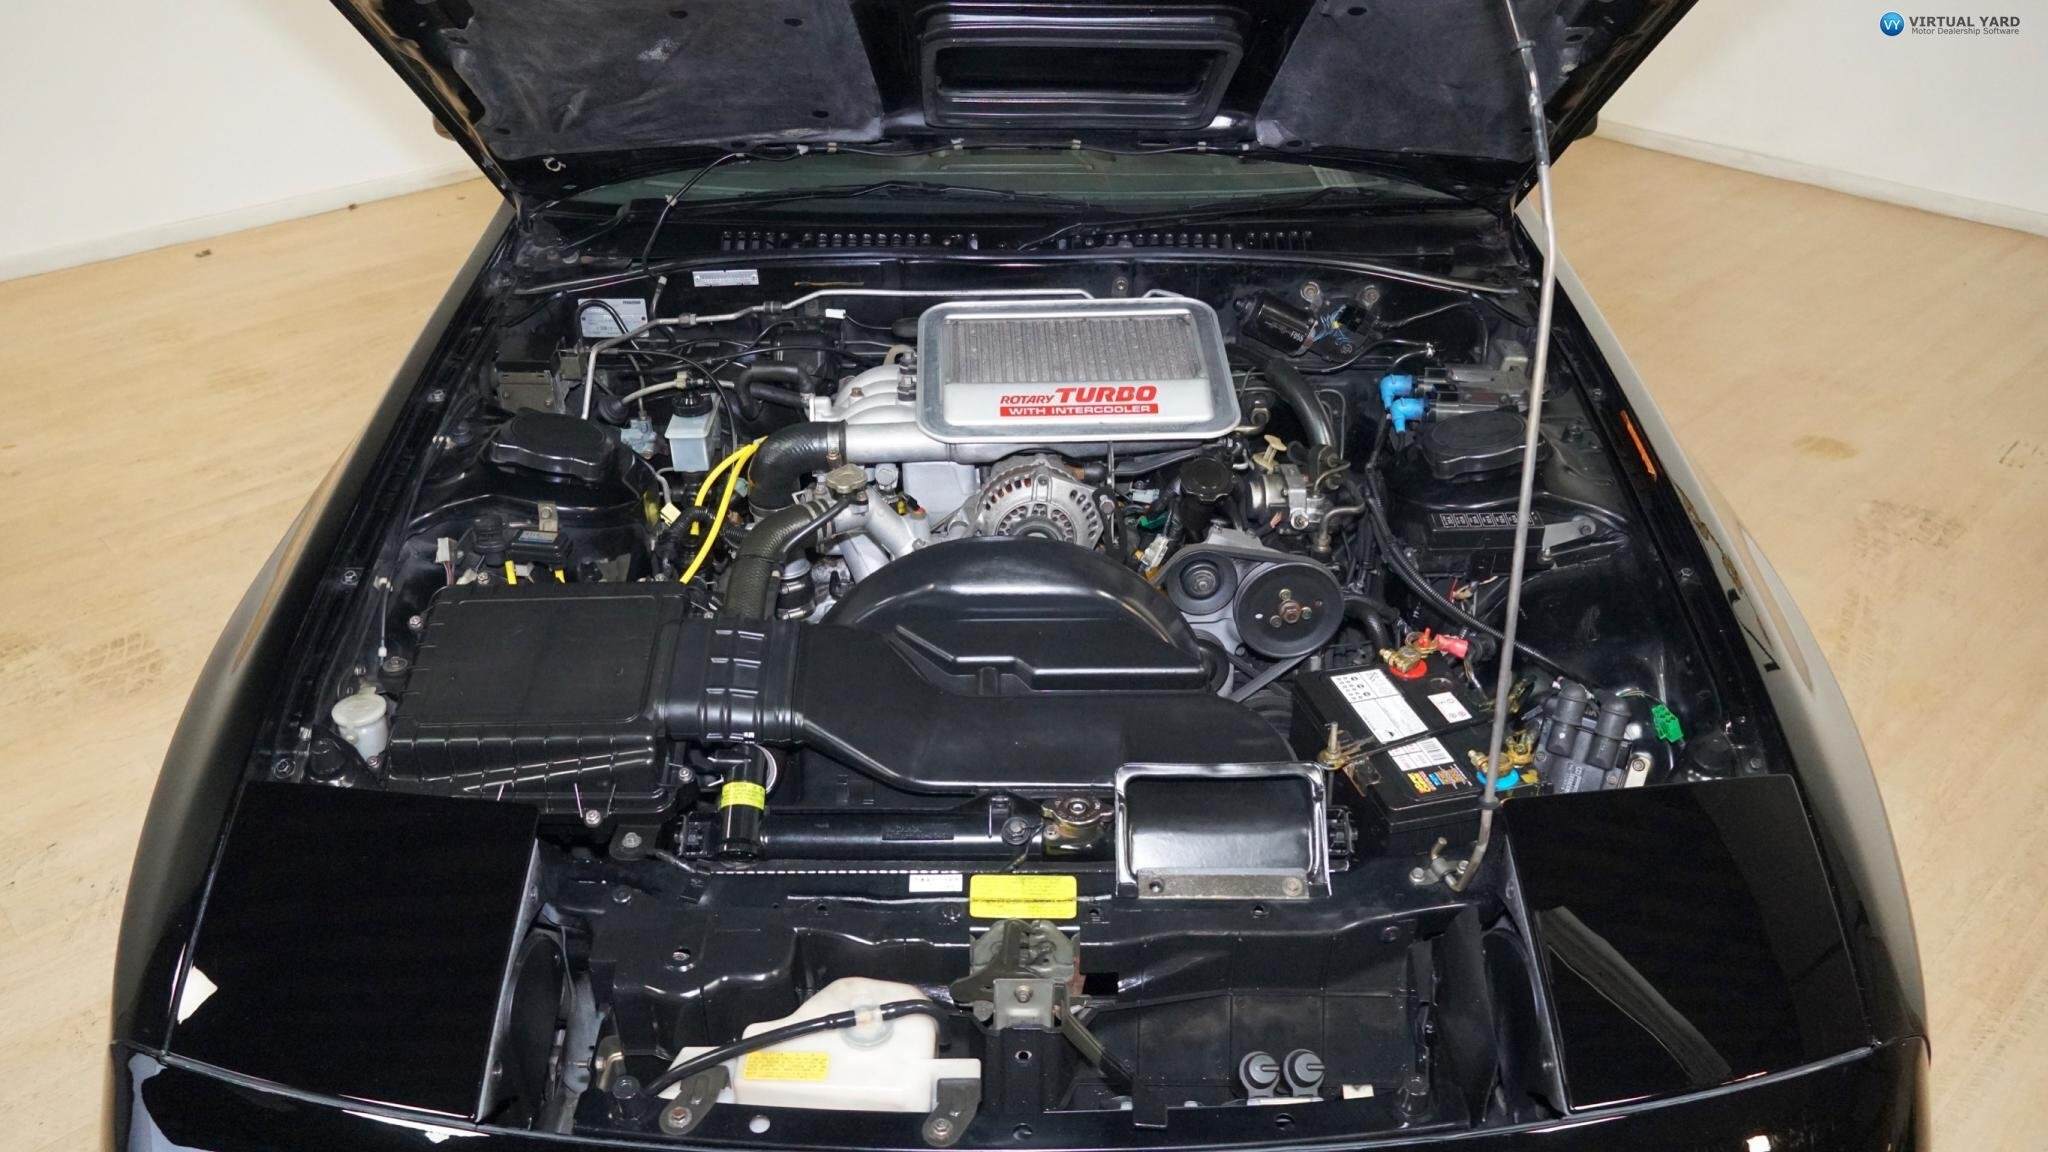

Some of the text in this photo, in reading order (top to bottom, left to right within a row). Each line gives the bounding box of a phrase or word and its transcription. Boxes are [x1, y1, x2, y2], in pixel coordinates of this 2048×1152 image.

[1000, 385, 1158, 405] ROTARY TURBO
[1009, 405, 1151, 416] WITH INTERCOOLER
